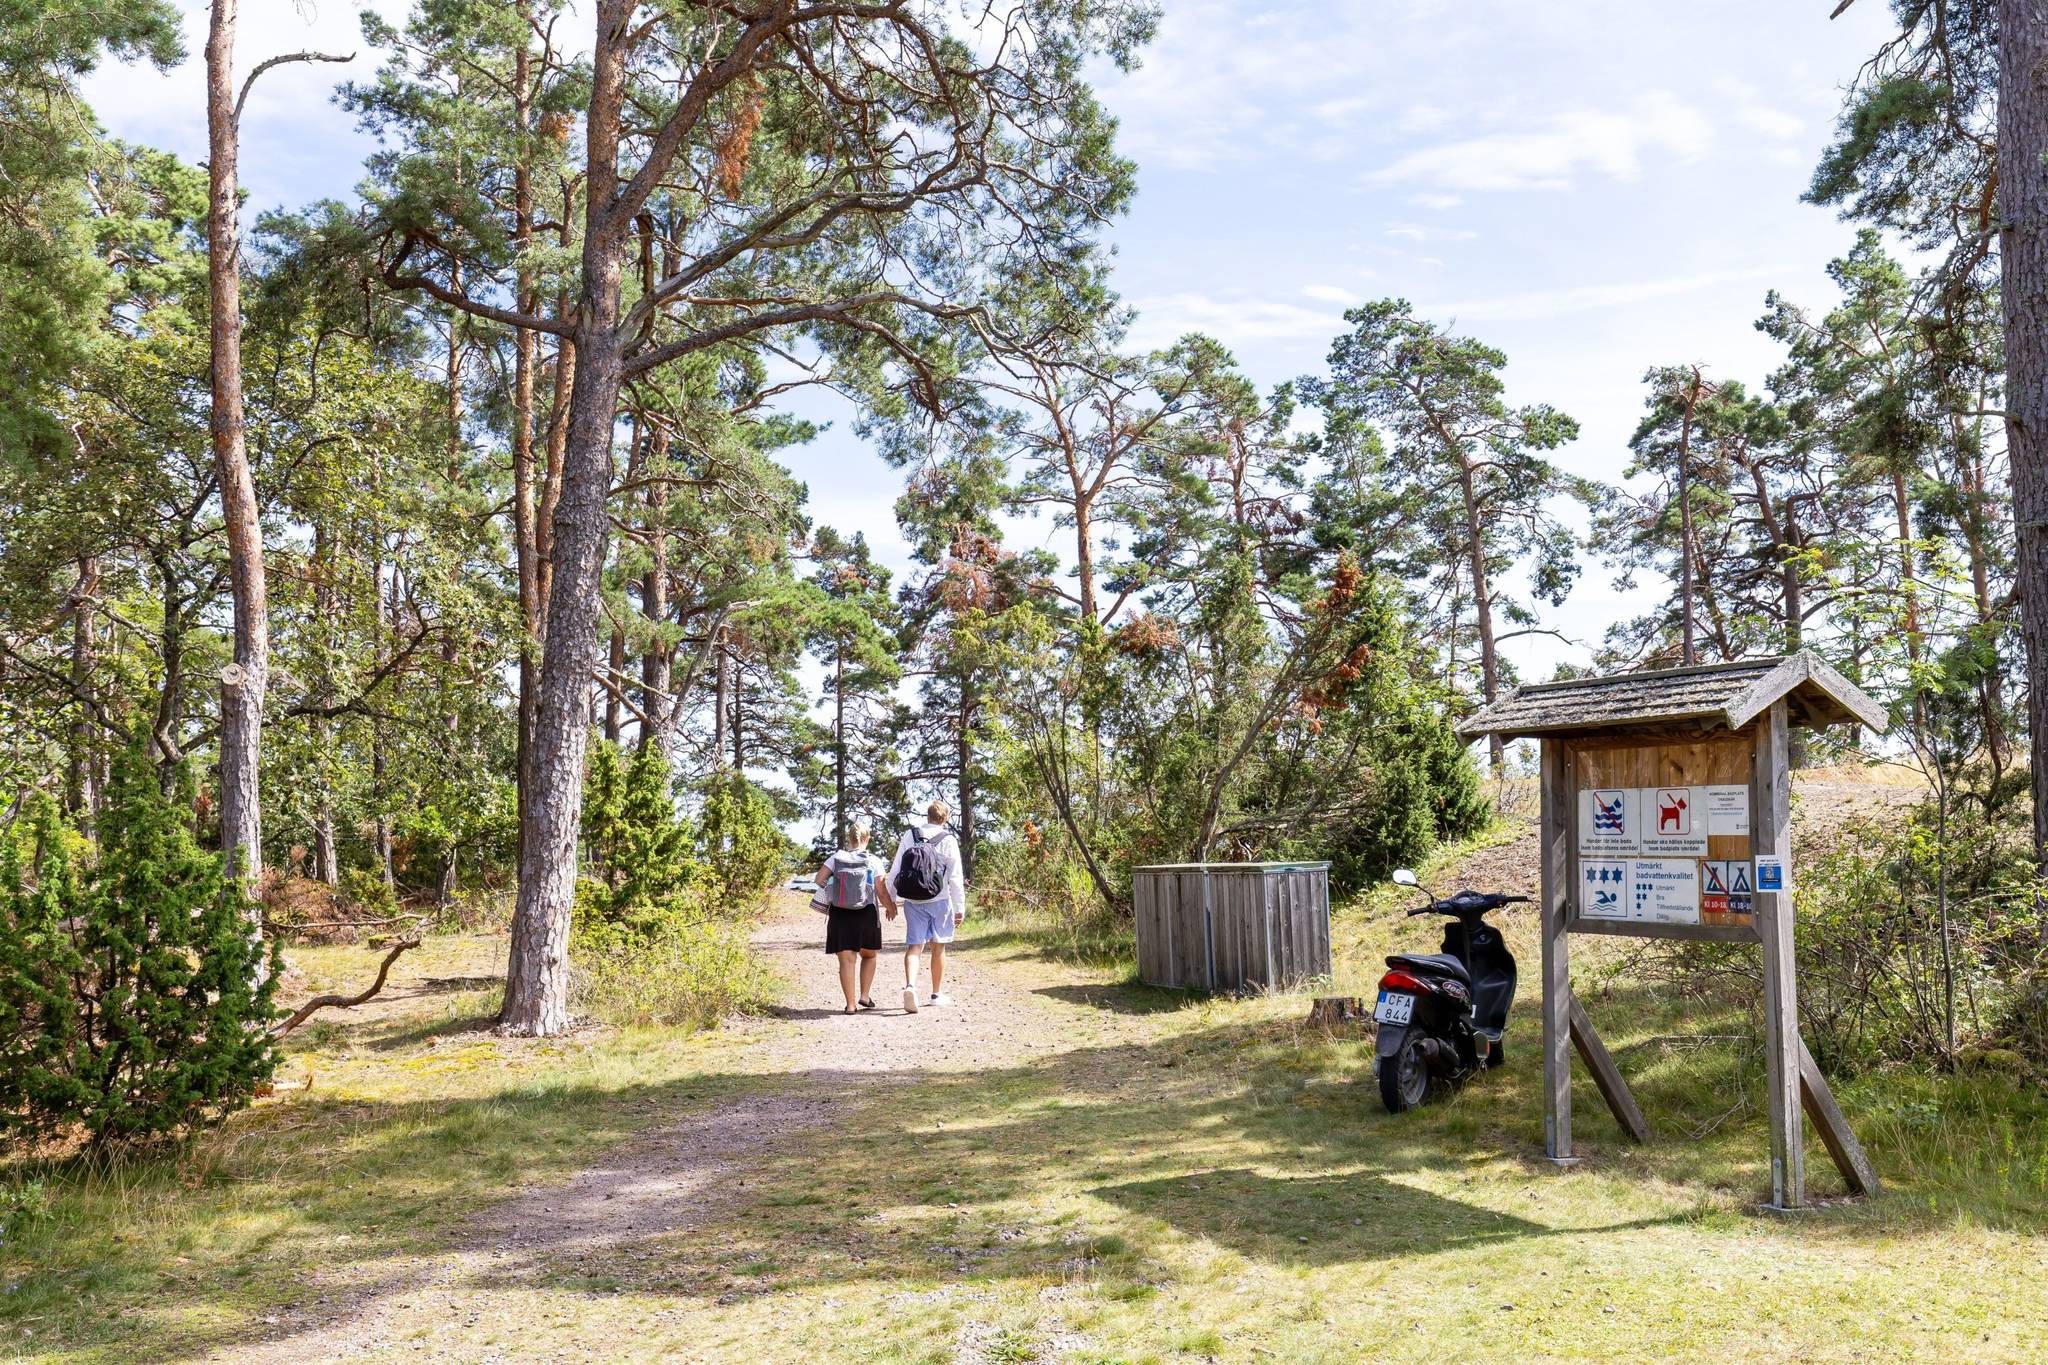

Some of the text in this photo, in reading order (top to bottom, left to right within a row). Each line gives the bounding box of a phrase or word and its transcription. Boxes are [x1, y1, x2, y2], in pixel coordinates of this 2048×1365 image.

[1636, 862, 1662, 870] Utmärkt
[1636, 872, 1693, 880] badvattenkvalitet
[1388, 995, 1410, 1008] CFA
[1385, 1008, 1408, 1021] 844
